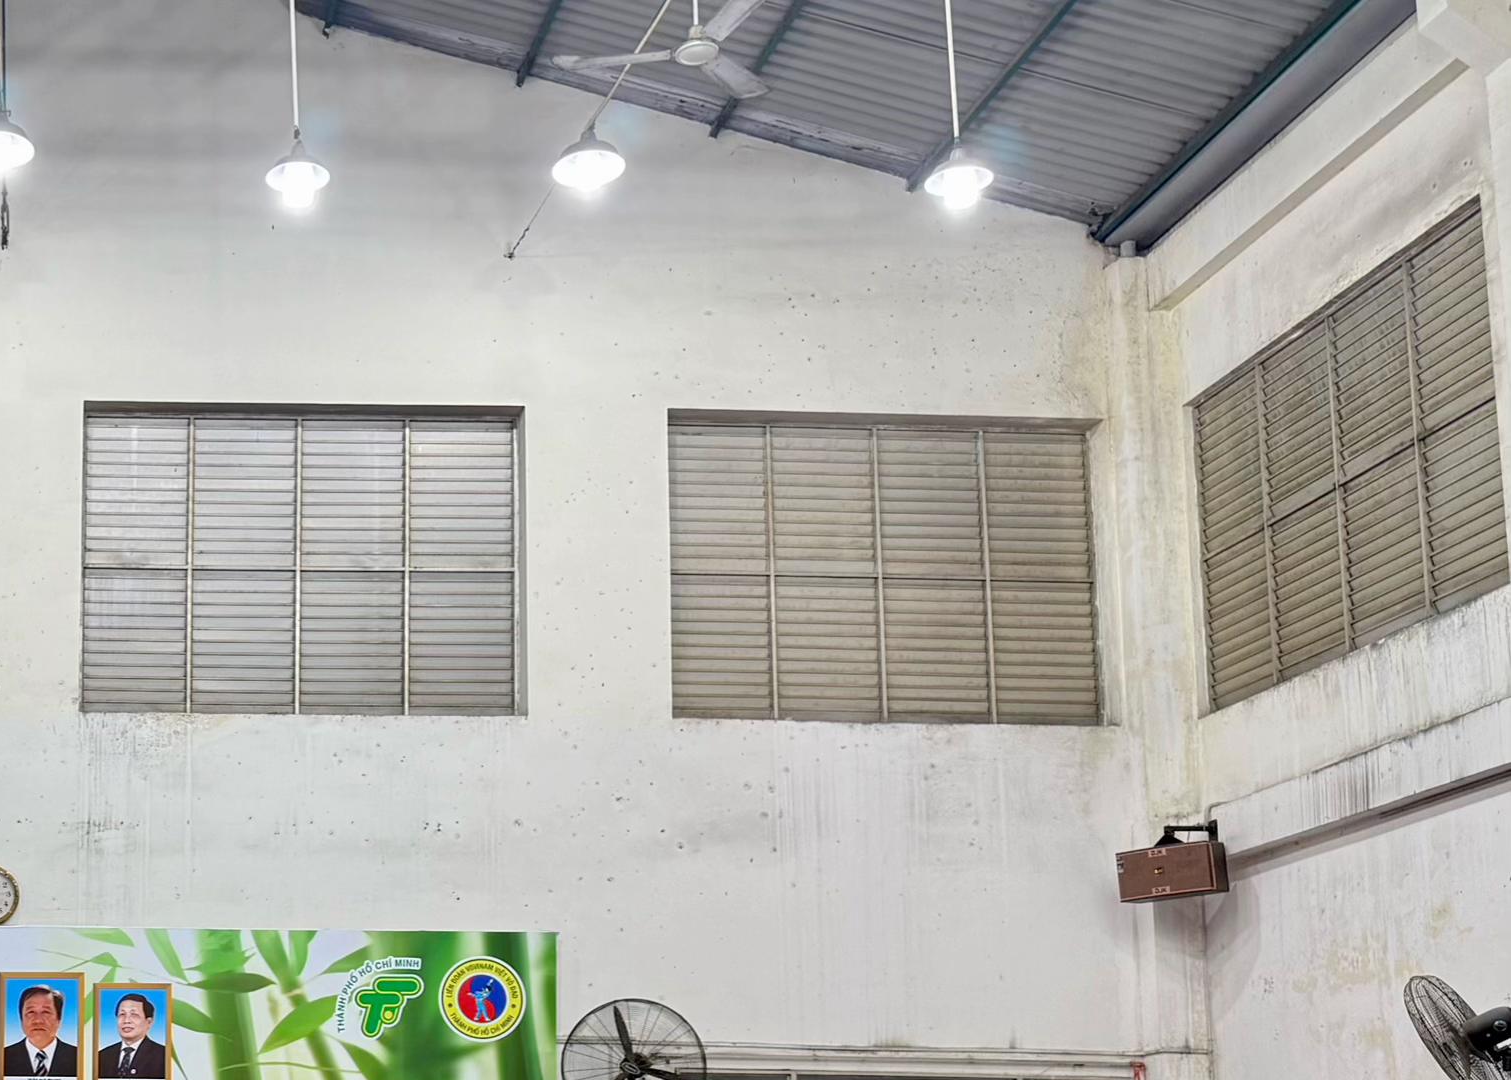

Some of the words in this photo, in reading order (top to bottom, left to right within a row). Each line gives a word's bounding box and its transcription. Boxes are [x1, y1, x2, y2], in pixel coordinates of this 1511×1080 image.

[337, 995, 347, 1033] THÀNH
[342, 971, 360, 997] PHỐ
[374, 956, 394, 970] CHÍ
[394, 958, 421, 969] MINH
